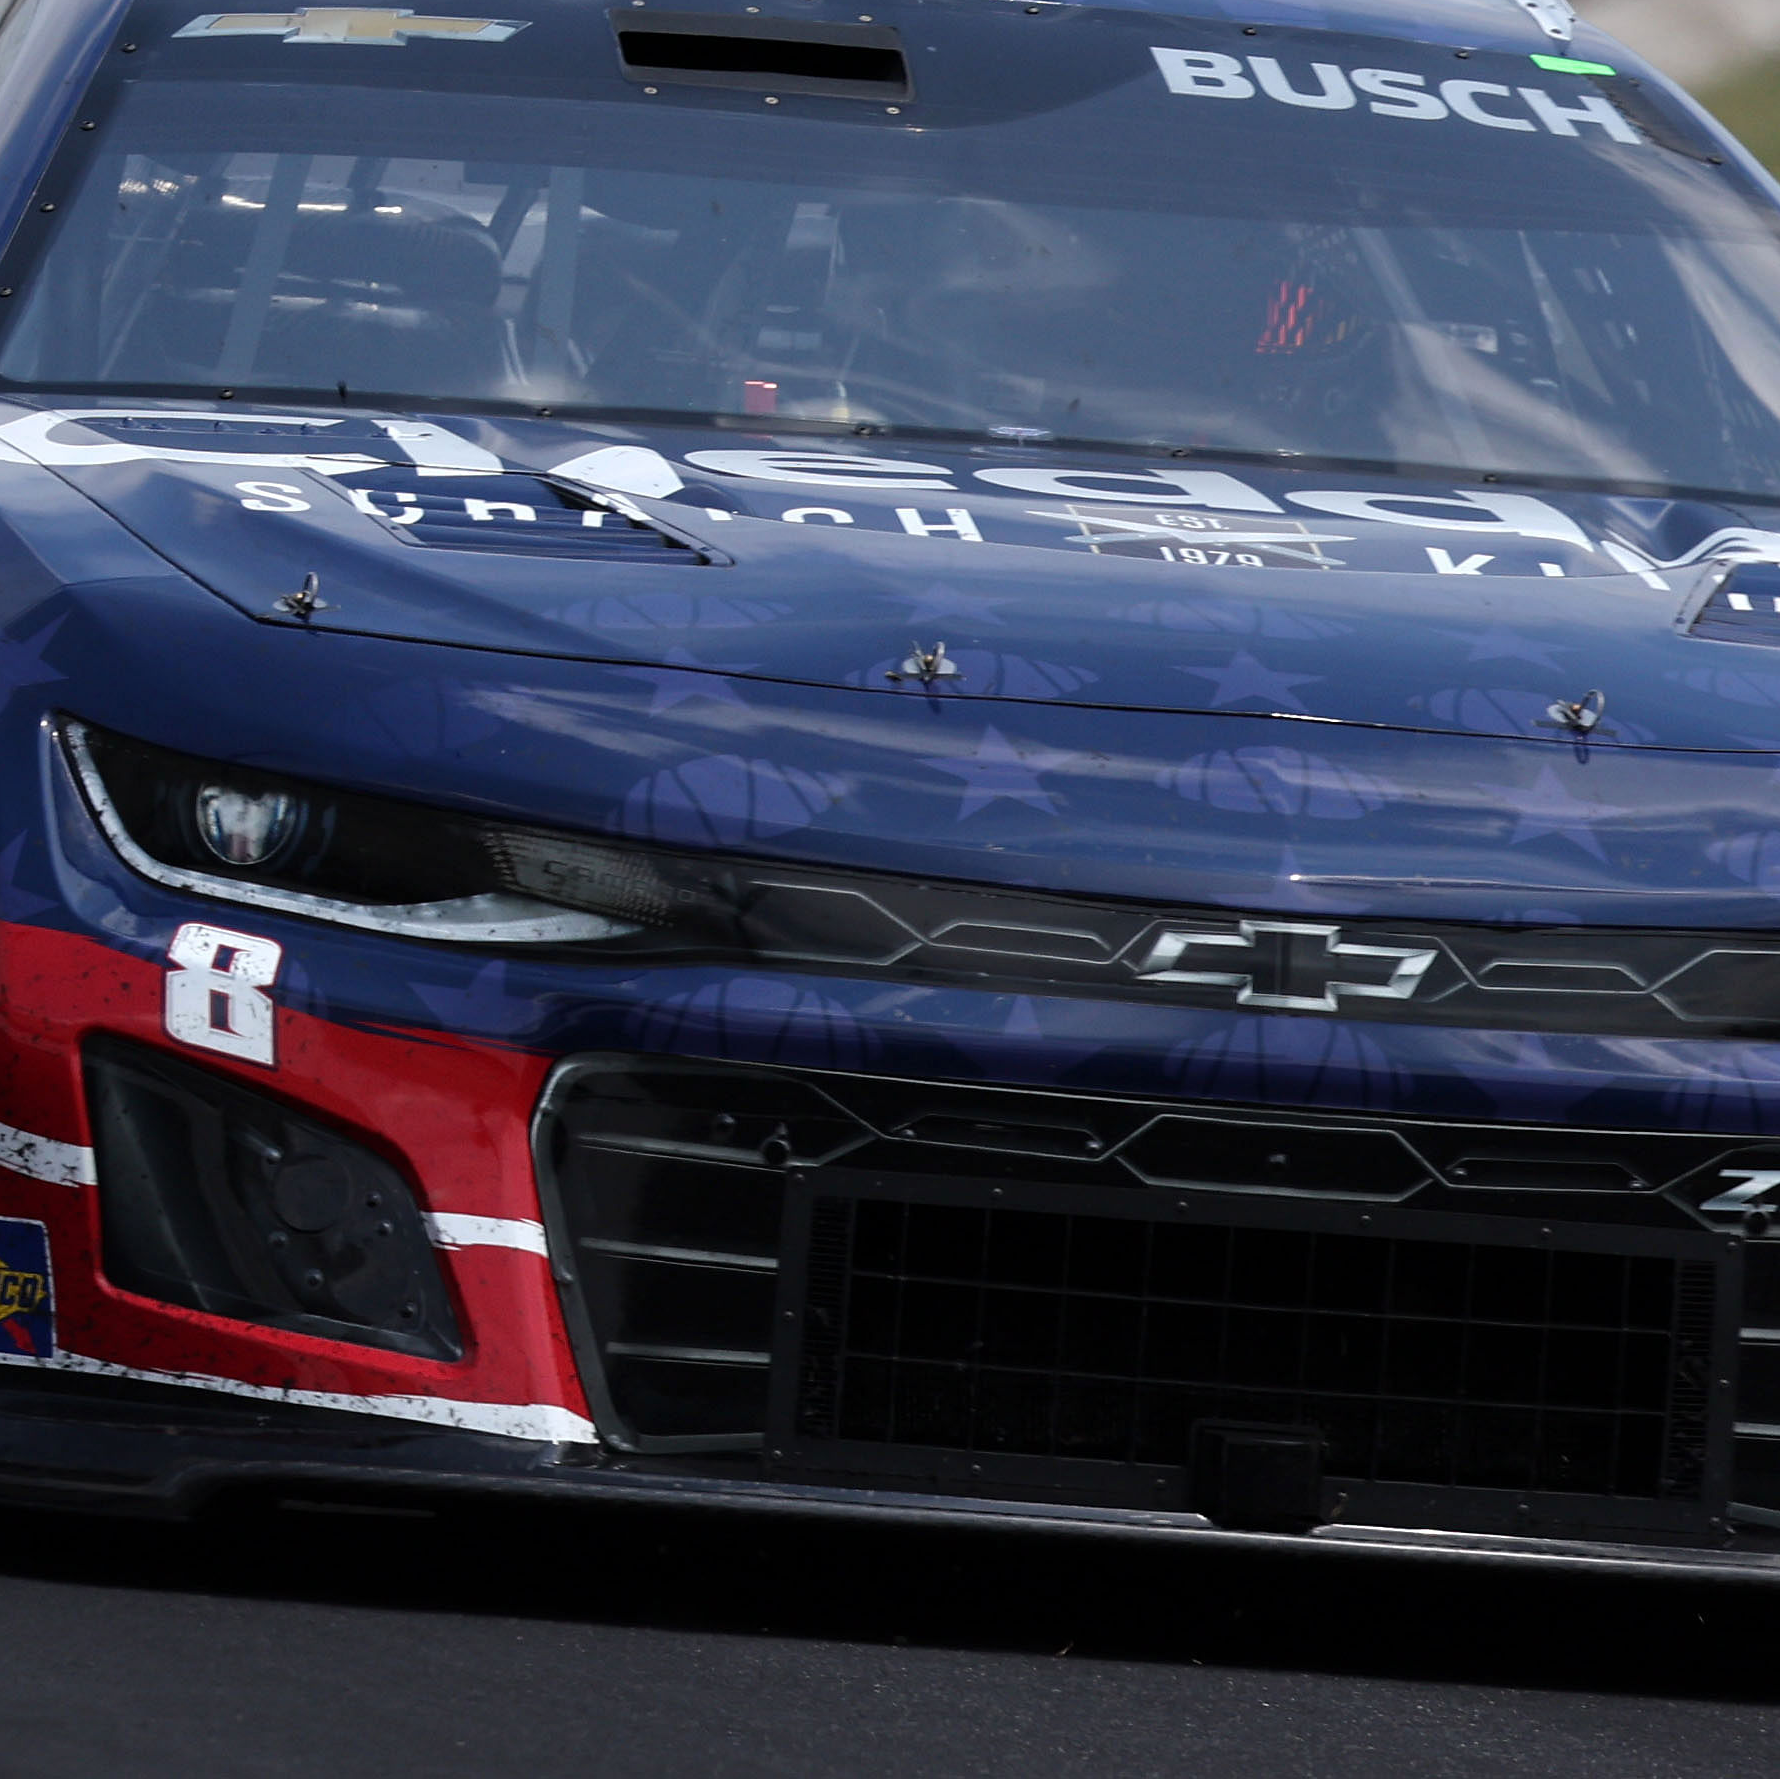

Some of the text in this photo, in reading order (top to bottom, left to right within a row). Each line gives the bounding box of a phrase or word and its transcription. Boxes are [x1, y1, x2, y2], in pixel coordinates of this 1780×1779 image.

[1149, 46, 1642, 146] BUSCH
[1155, 512, 1231, 531] EST.
[1158, 545, 1265, 569] 1979
[165, 922, 283, 1067] 8
